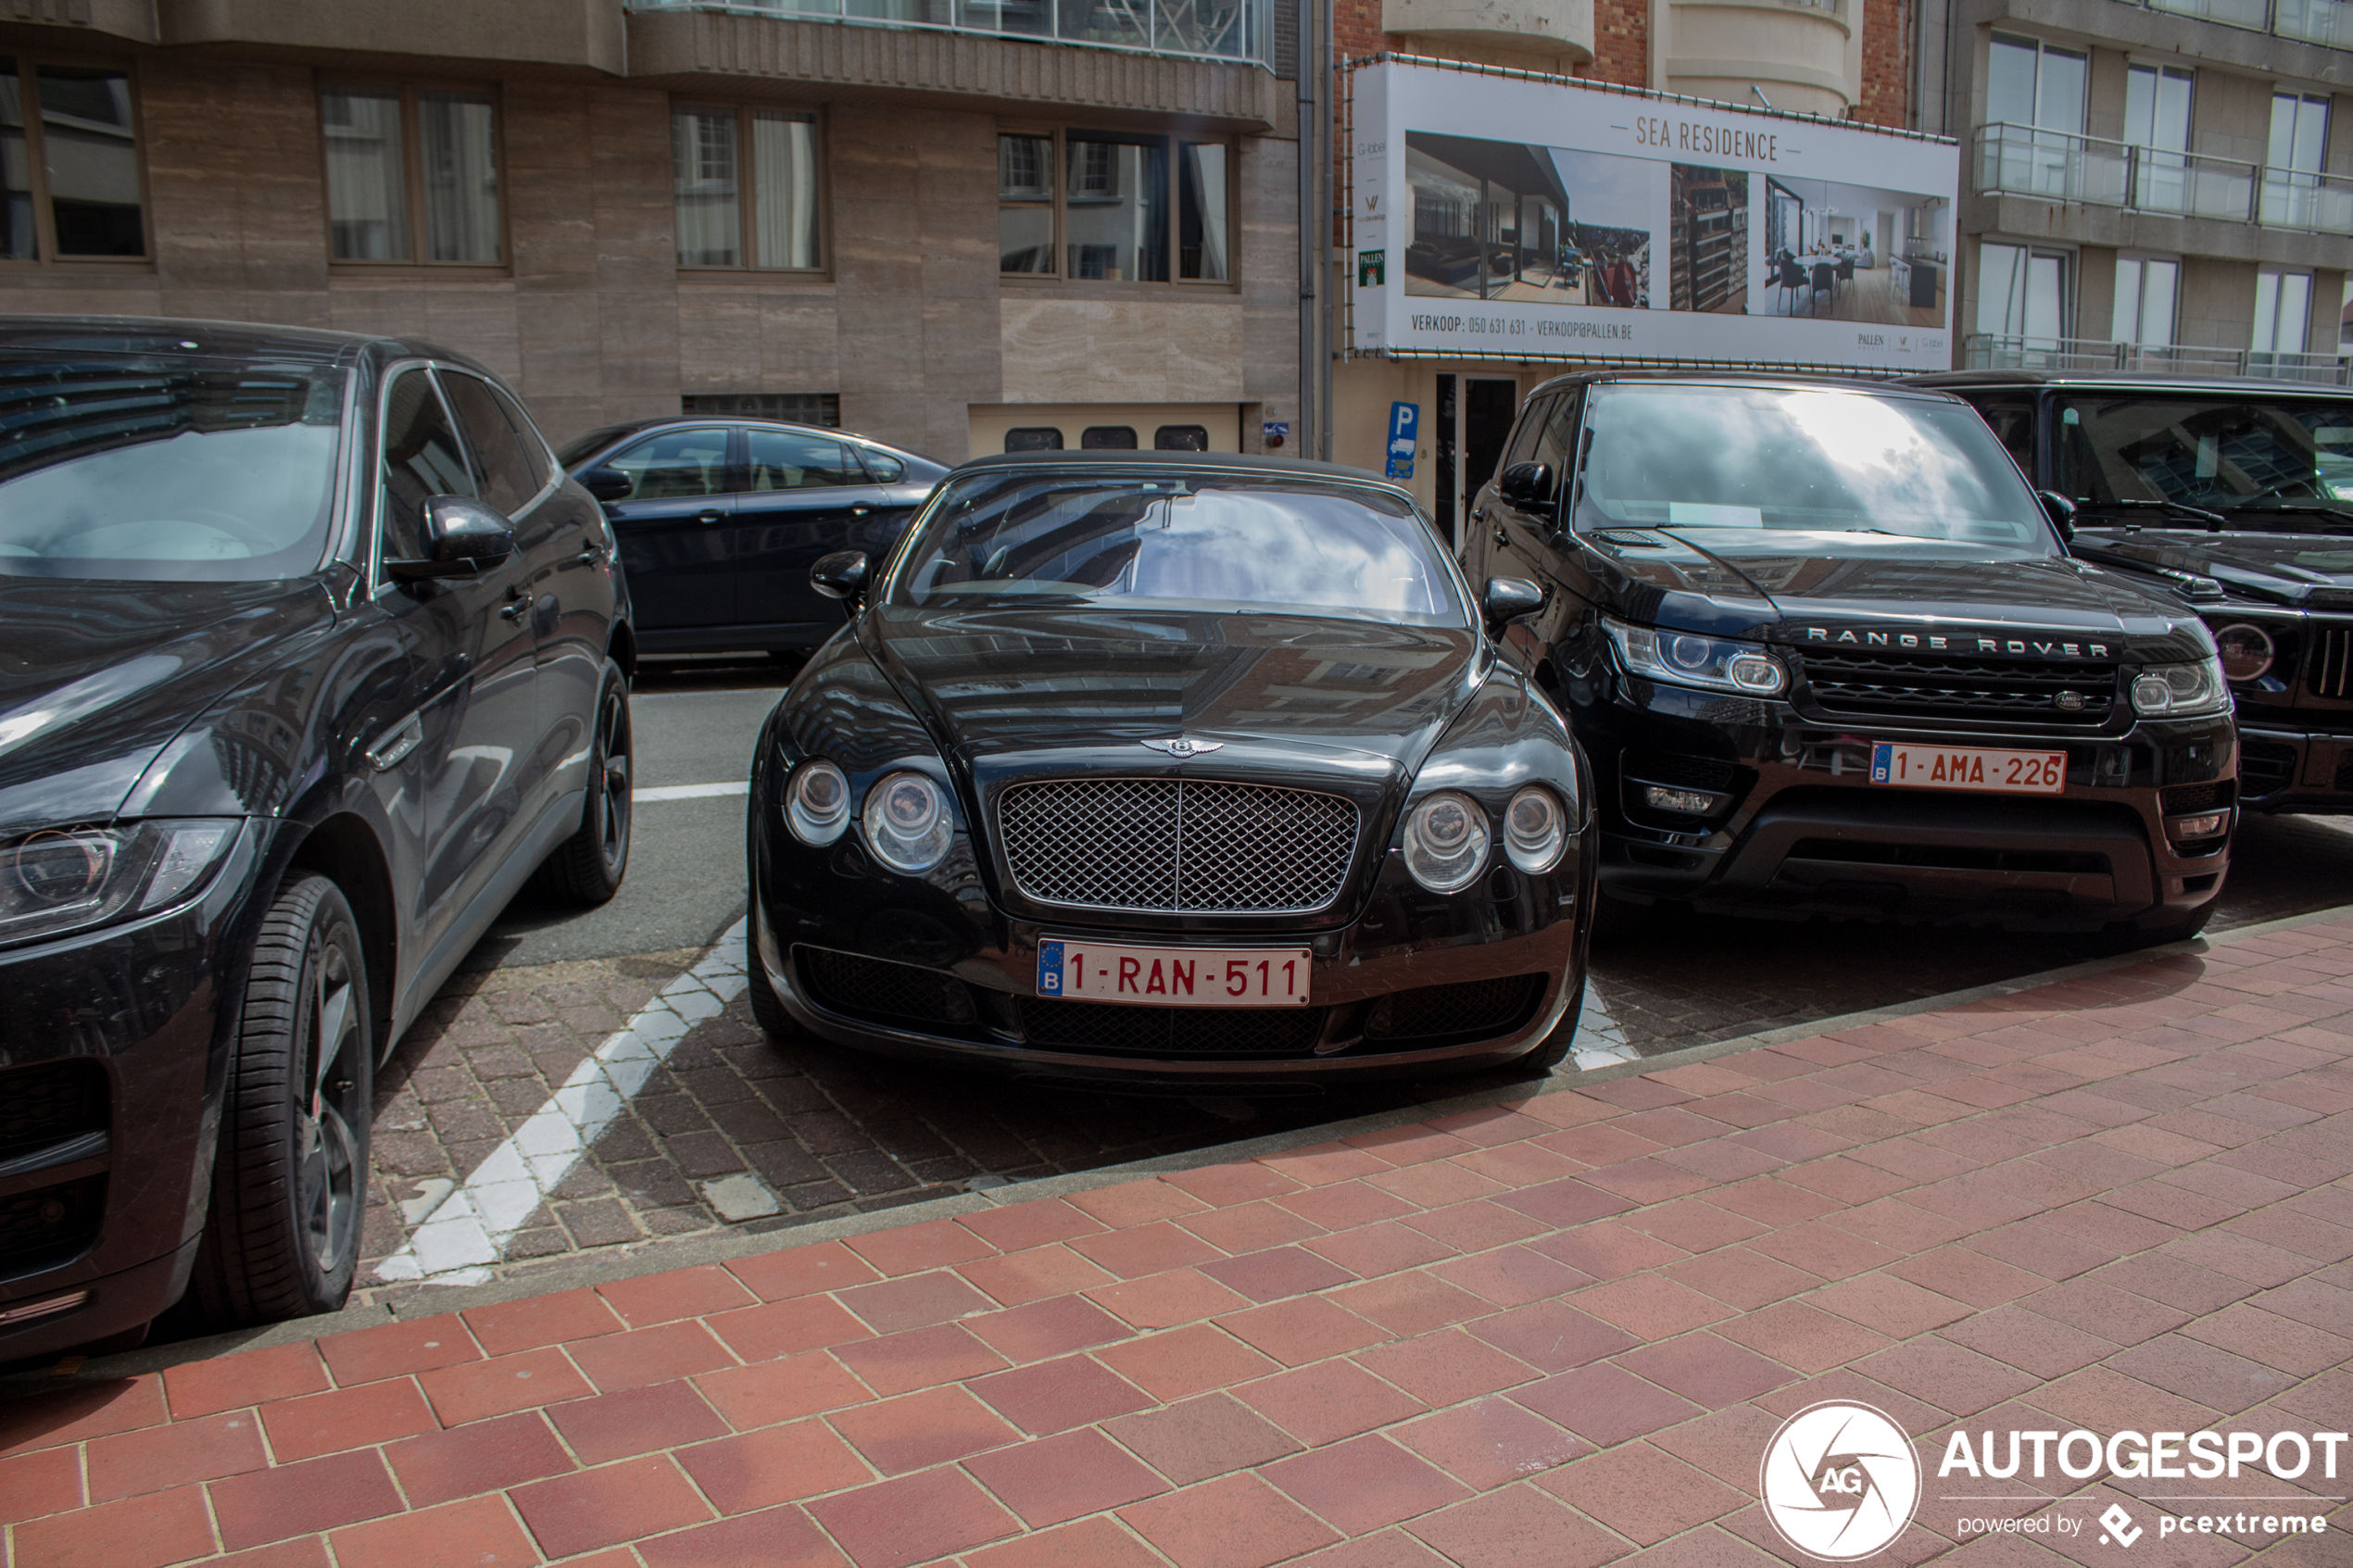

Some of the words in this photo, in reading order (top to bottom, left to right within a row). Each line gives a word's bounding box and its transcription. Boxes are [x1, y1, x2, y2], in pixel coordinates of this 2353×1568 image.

[1636, 116, 1671, 148] SEA
[1680, 121, 1778, 162] RESIDENCE
[1360, 252, 1384, 264] PALLEN
[1412, 314, 1466, 332] VERKOOP:
[1468, 317, 1487, 333] 050
[1489, 318, 1506, 334] 631
[1509, 319, 1527, 335] 631
[1537, 320, 1632, 340] VERKOOP@PALLEN.BE
[1858, 333, 1884, 346] PALLEN
[1396, 405, 1414, 435] P
[1421, 449, 1428, 459] 8
[1807, 627, 1947, 649] RANGE
[1977, 638, 2108, 658] ROVER
[1876, 767, 1887, 781] B
[1044, 972, 1059, 990] B
